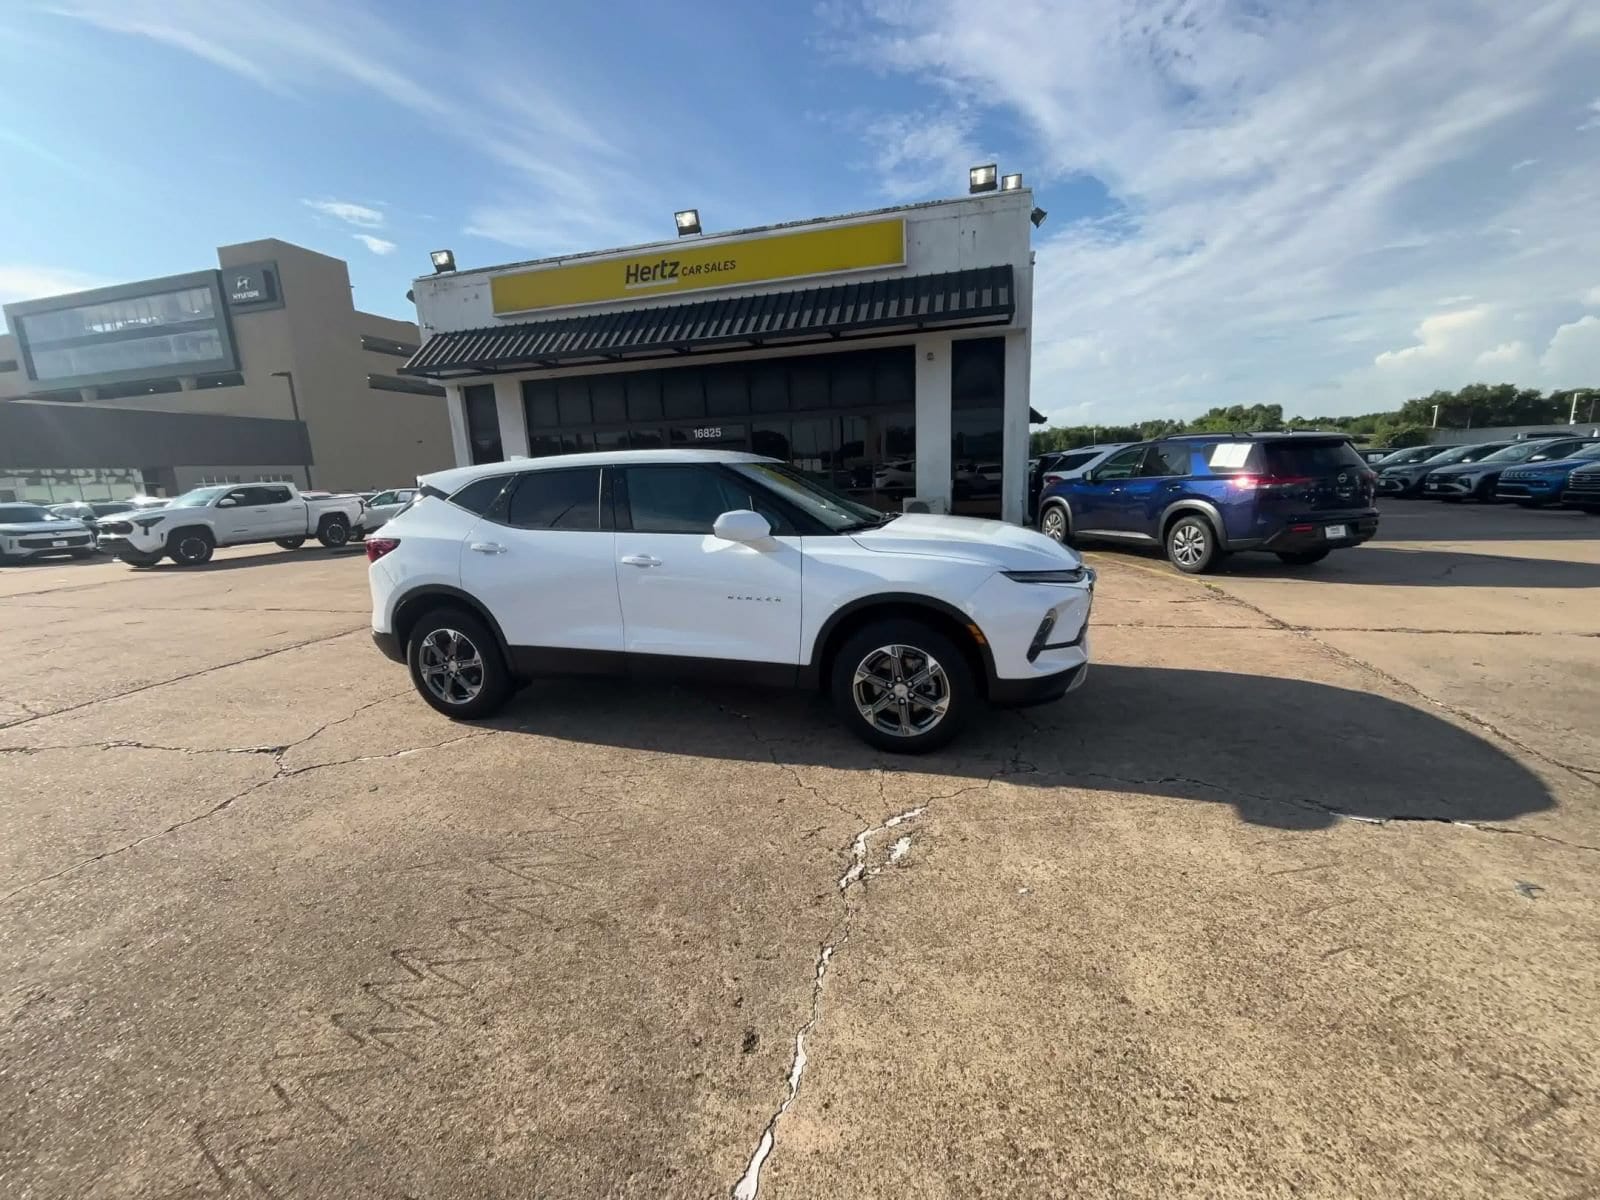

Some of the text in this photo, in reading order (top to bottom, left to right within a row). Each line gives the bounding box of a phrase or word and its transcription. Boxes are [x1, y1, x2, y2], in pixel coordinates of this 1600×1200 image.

[625, 259, 736, 284] Hertz CAR SALES
[693, 427, 722, 438] 16825
